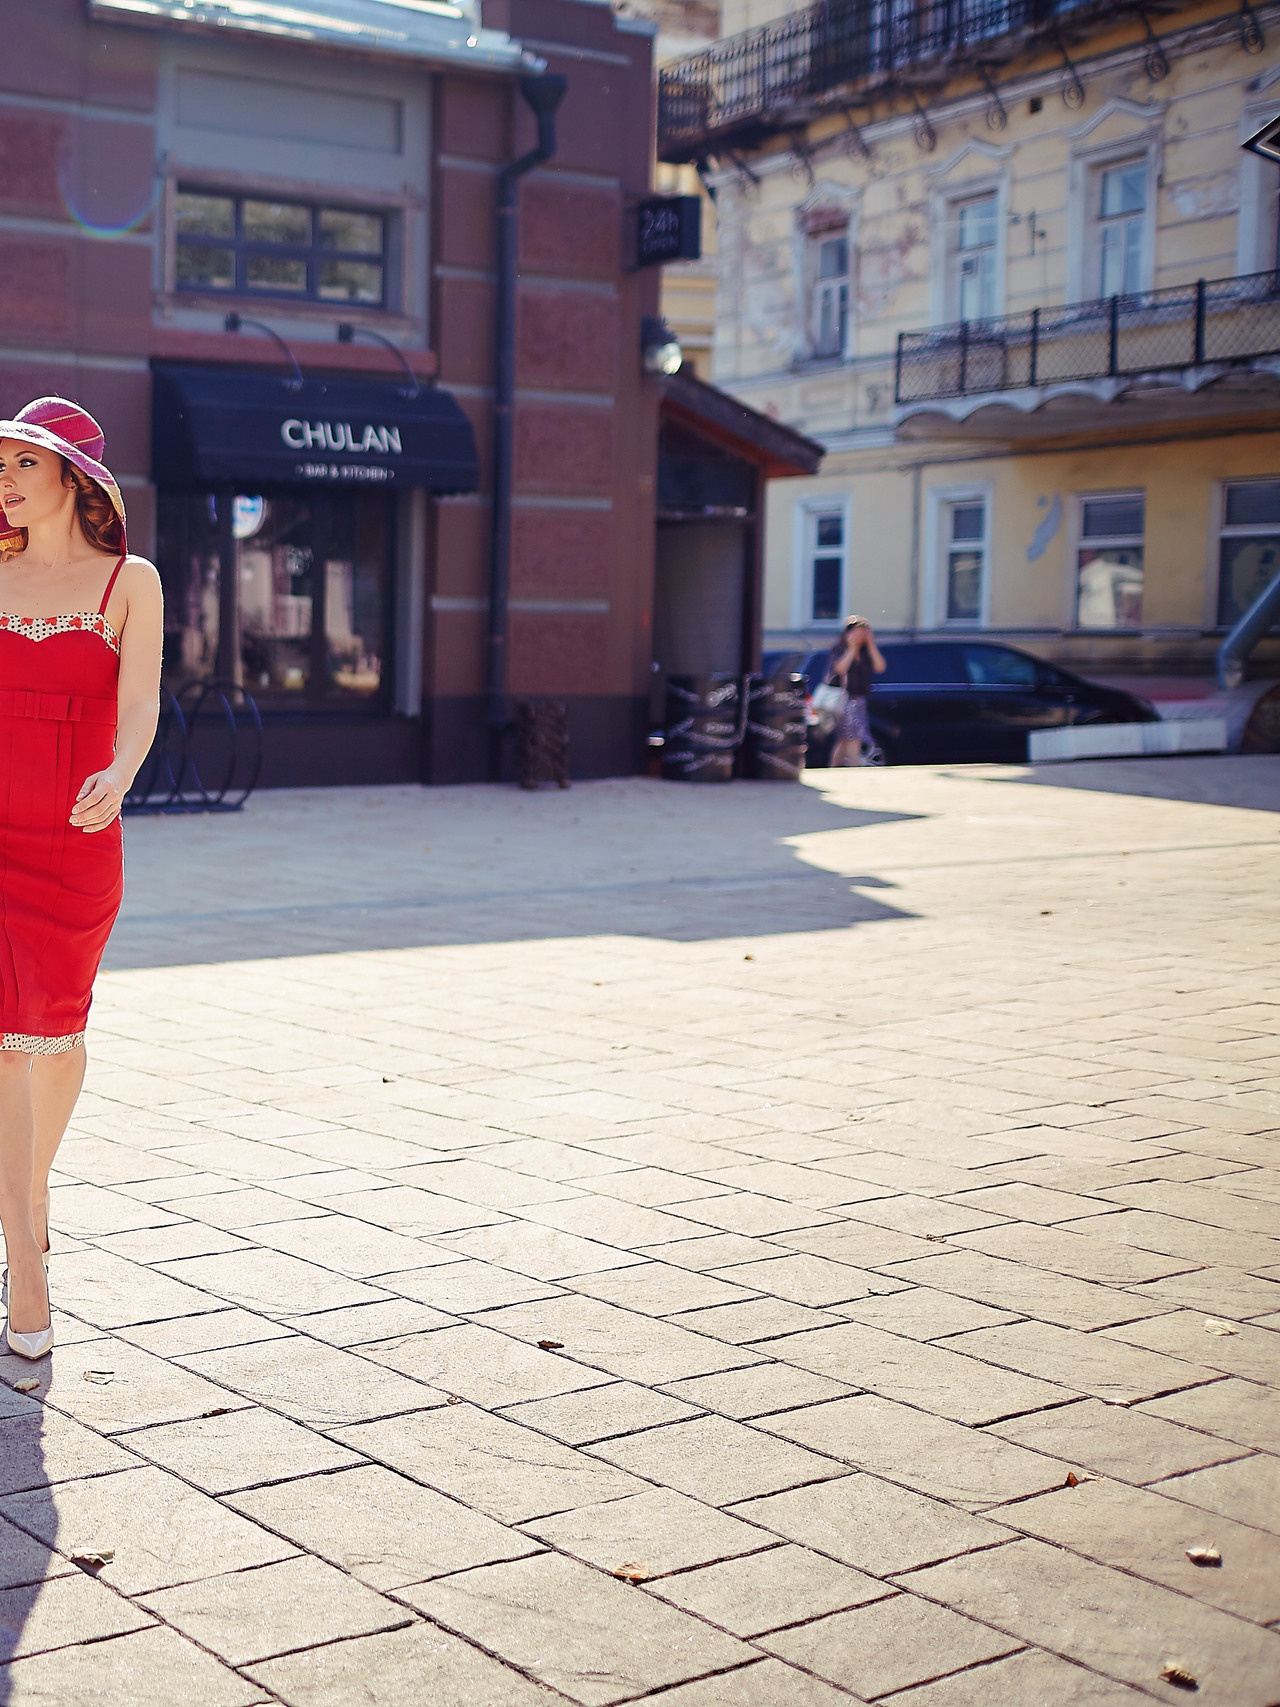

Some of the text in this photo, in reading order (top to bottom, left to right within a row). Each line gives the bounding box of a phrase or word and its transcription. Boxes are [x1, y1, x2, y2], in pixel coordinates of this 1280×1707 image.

[281, 419, 402, 454] CHULAN
[304, 463, 327, 478] BAR
[341, 464, 388, 481] KITCHEN
